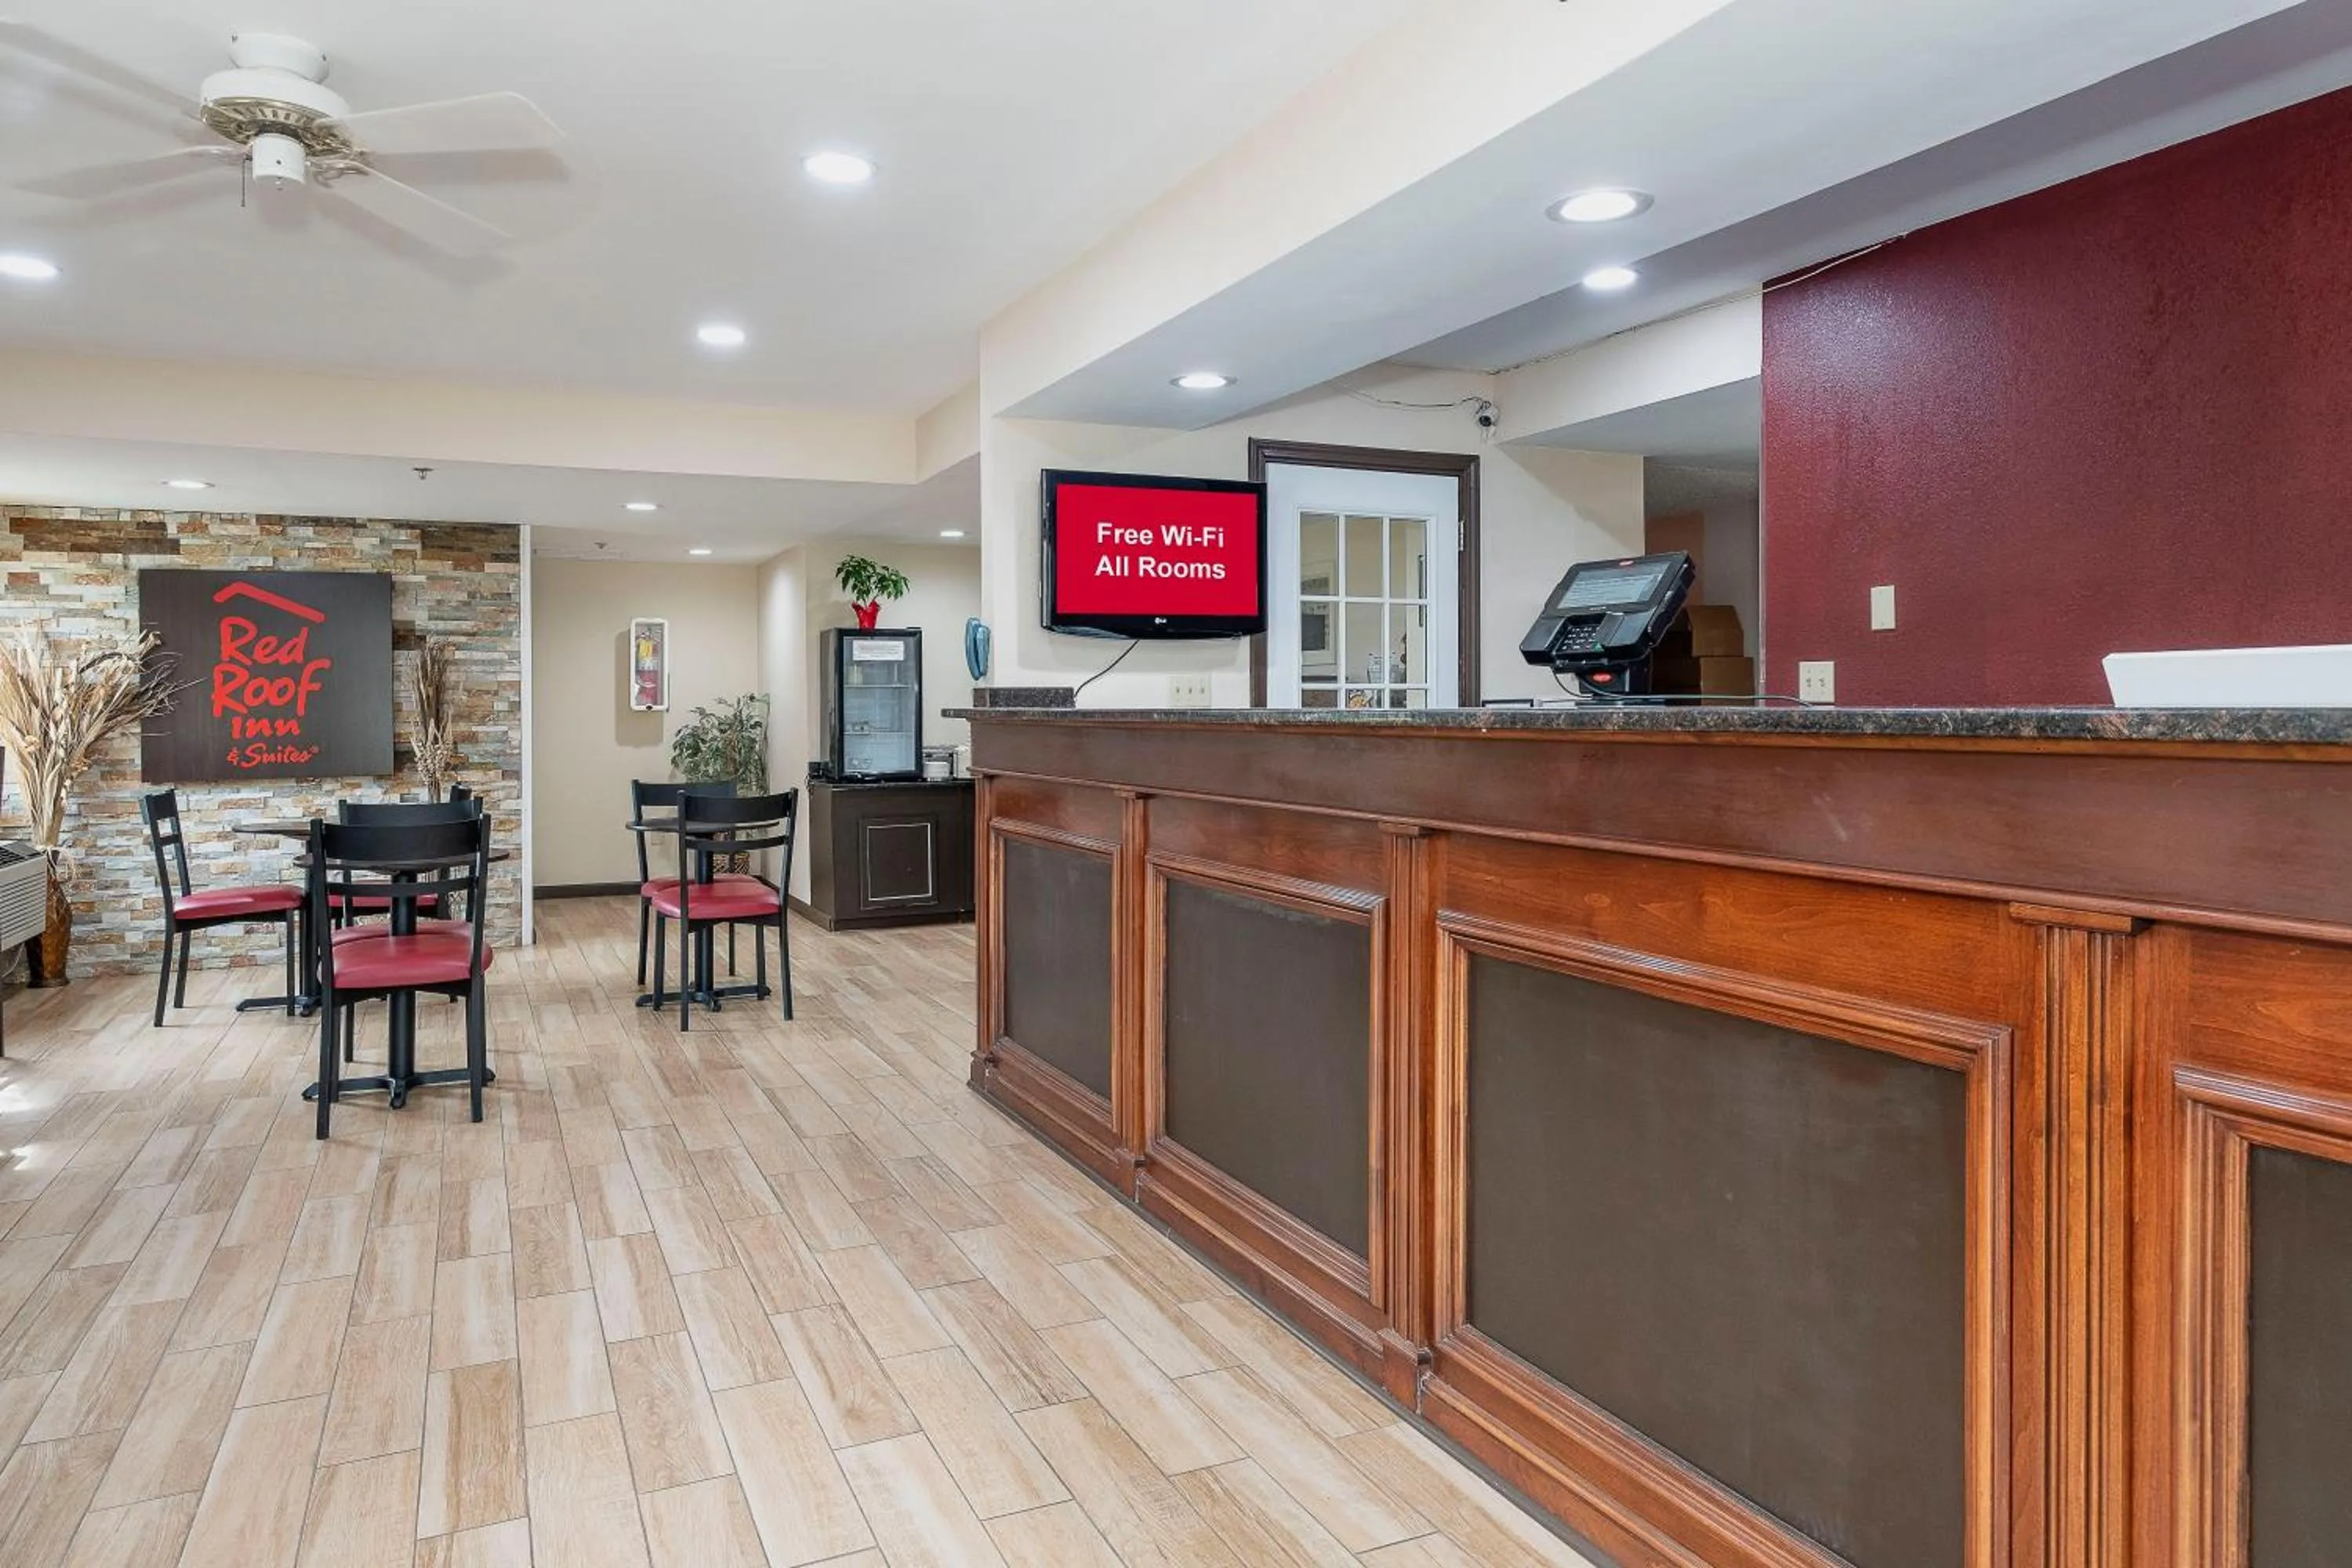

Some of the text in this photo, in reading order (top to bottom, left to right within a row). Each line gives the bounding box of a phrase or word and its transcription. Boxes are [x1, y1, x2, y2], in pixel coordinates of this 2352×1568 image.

[1097, 522, 1224, 548] Free Wi-Fi
[1094, 554, 1226, 579] All Rooms
[219, 616, 309, 666] Red
[211, 659, 331, 717] Roof
